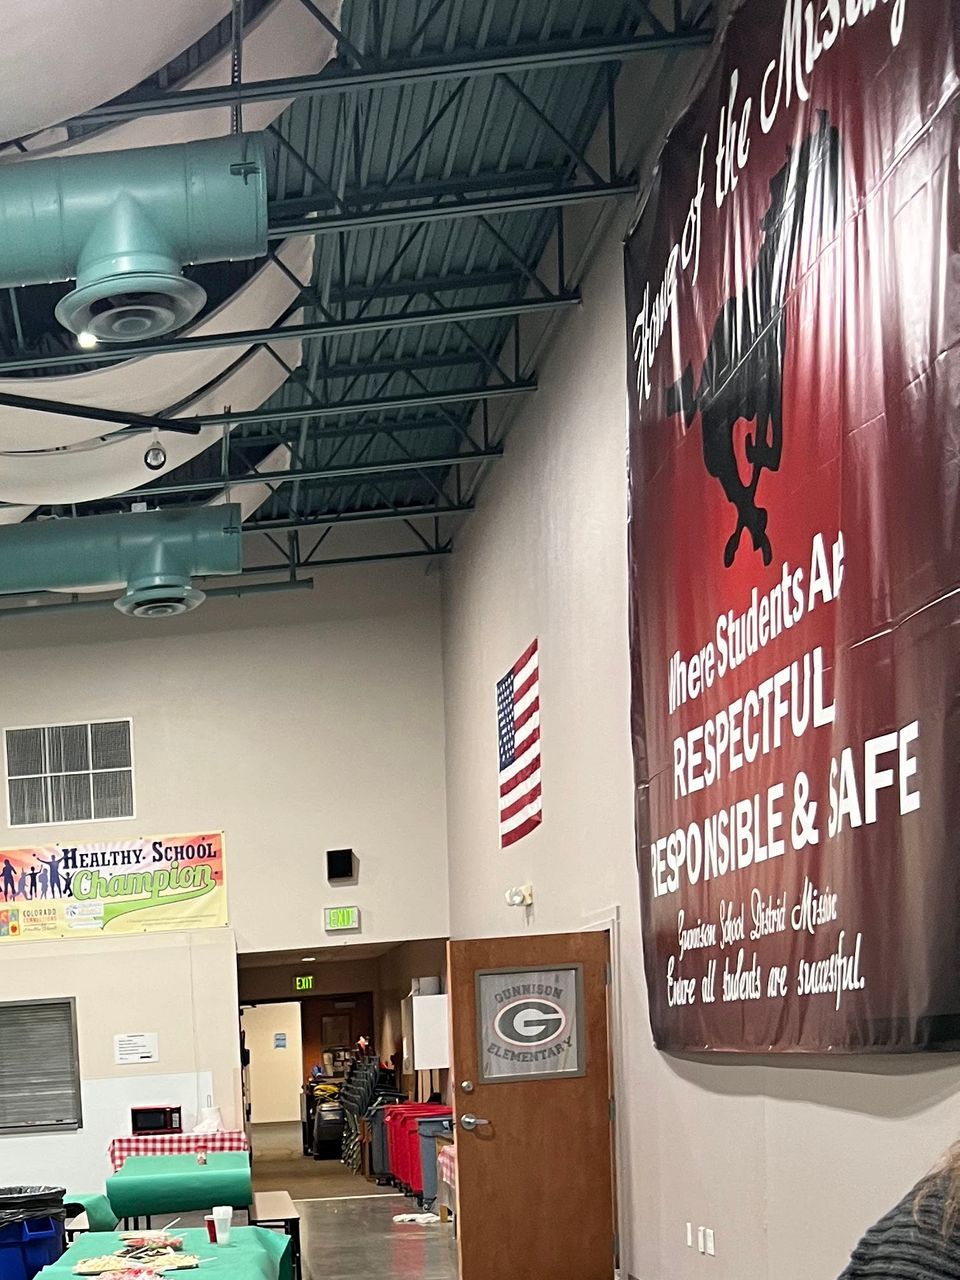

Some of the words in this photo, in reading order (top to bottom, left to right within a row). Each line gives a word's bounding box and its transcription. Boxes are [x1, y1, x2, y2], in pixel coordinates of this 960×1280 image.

[632, 243, 680, 412] Home
[682, 133, 707, 286] of
[716, 68, 752, 207] the
[716, 561, 804, 678] Students
[673, 646, 836, 800] RESPECTFUL
[650, 782, 785, 898] RESPONSIBLE
[790, 771, 819, 850] &
[828, 720, 921, 839] SAFE
[72, 861, 214, 901] Champion
[23, 908, 57, 917] COLORADO
[329, 907, 354, 928] EXIT
[719, 899, 745, 950] School
[749, 888, 787, 941] District
[295, 975, 313, 990] EXIT
[494, 984, 564, 1003] GUNNISON
[701, 959, 717, 1003] all
[722, 947, 761, 1002] students
[767, 965, 788, 998] are
[497, 1001, 563, 1043] G
[487, 1036, 572, 1062] ELEMENTARY
